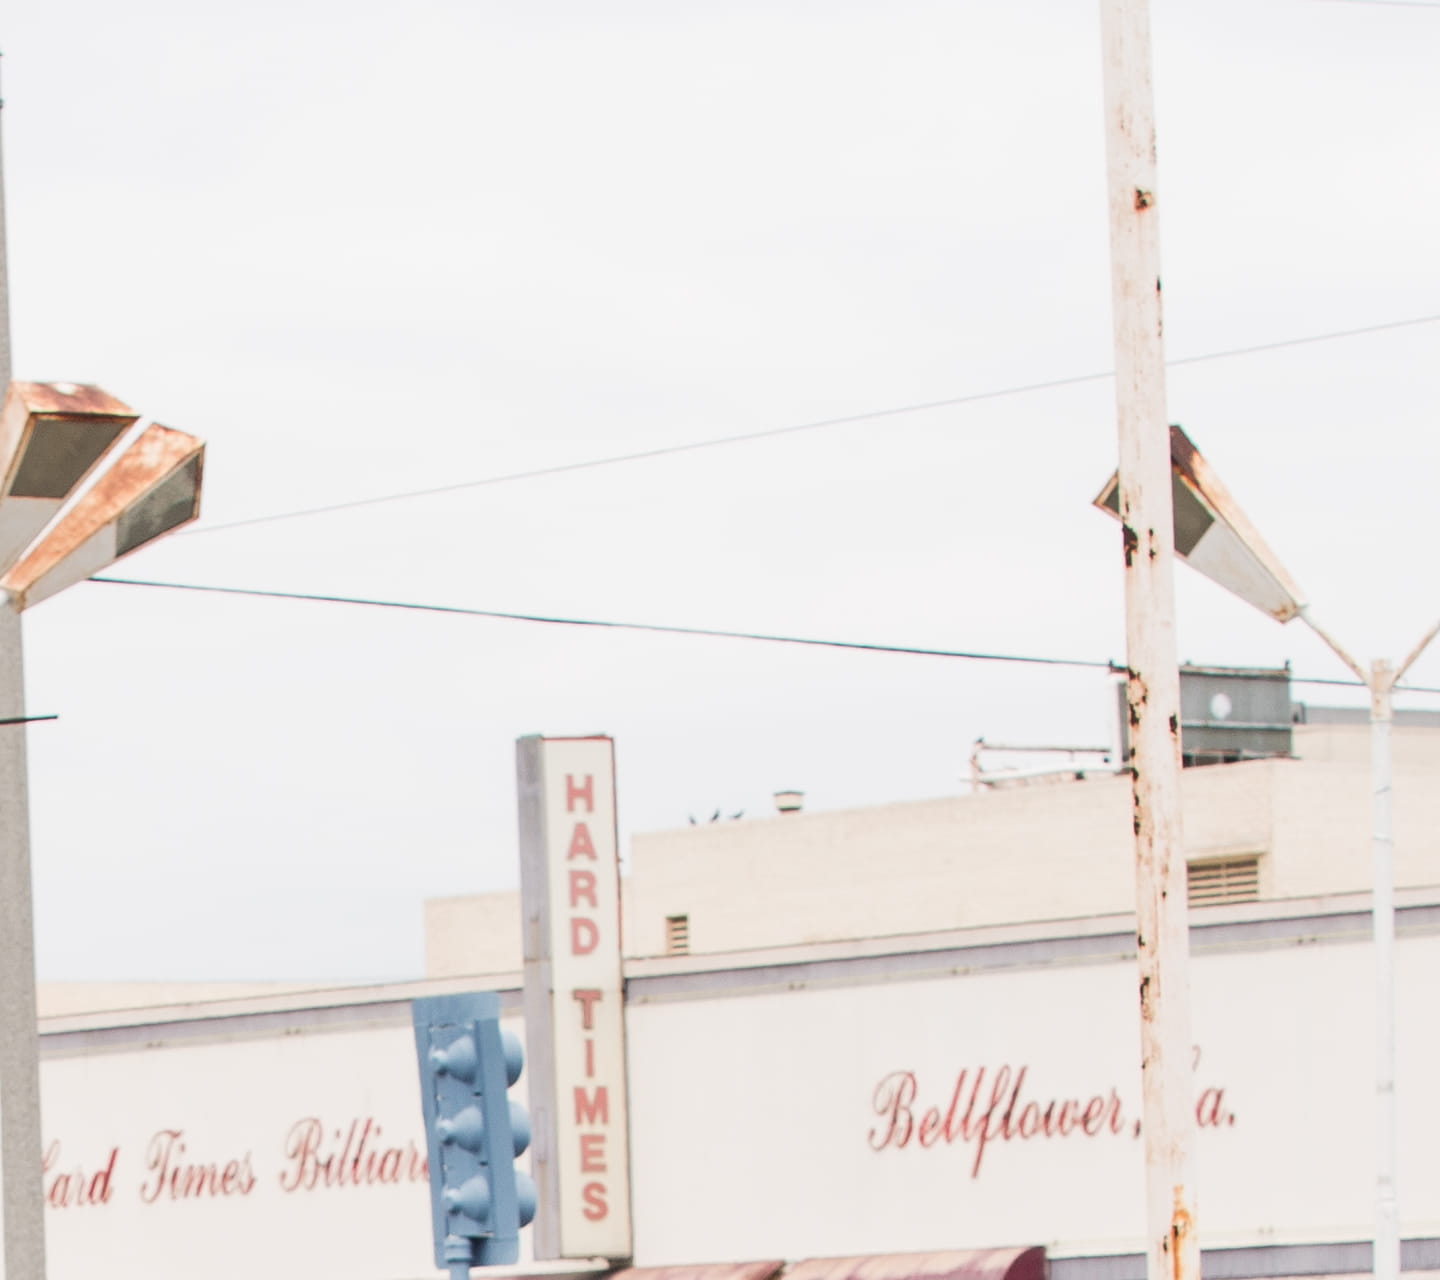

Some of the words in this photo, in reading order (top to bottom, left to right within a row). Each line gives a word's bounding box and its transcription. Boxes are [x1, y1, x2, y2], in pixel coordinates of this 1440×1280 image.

[566, 773, 600, 957] HARD
[140, 1128, 257, 1204] Times
[279, 1116, 429, 1193] Billiar
[573, 988, 609, 1222] TIMES
[868, 1064, 1141, 1179] Bellflower,
